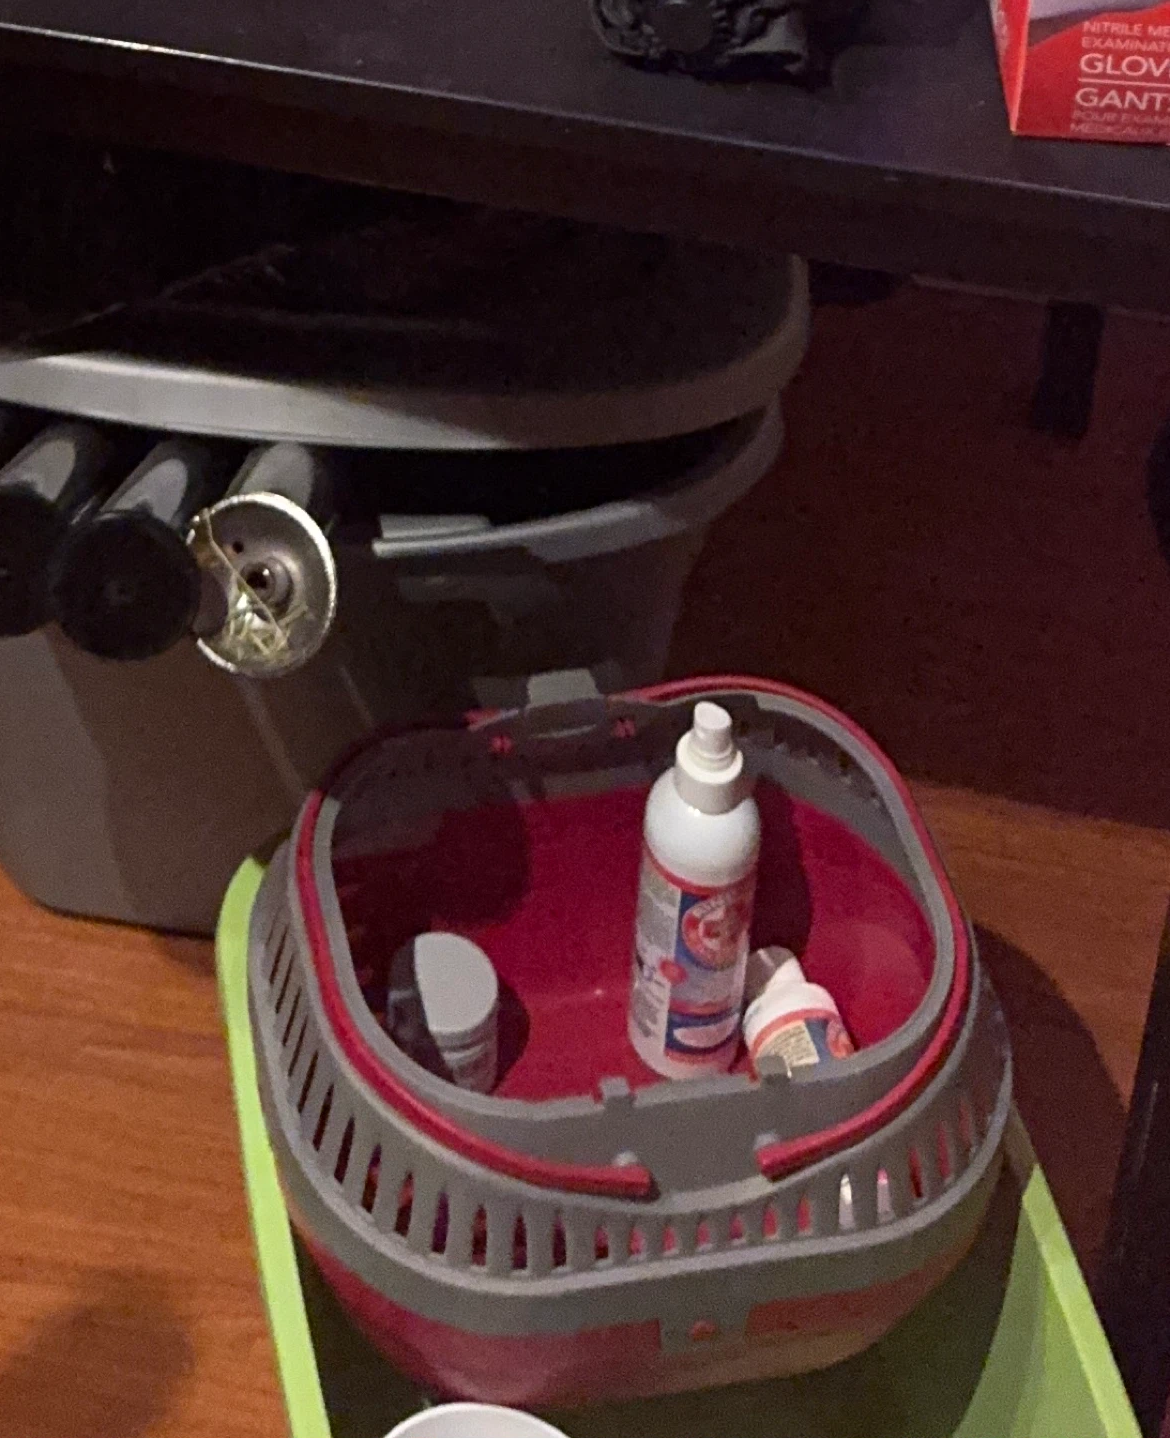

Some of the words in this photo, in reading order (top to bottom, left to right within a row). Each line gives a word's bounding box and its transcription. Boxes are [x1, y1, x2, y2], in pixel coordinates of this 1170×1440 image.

[1083, 21, 1143, 36] NITRILE
[1080, 53, 1170, 77] GLOV
[1075, 87, 1170, 111] GANT
